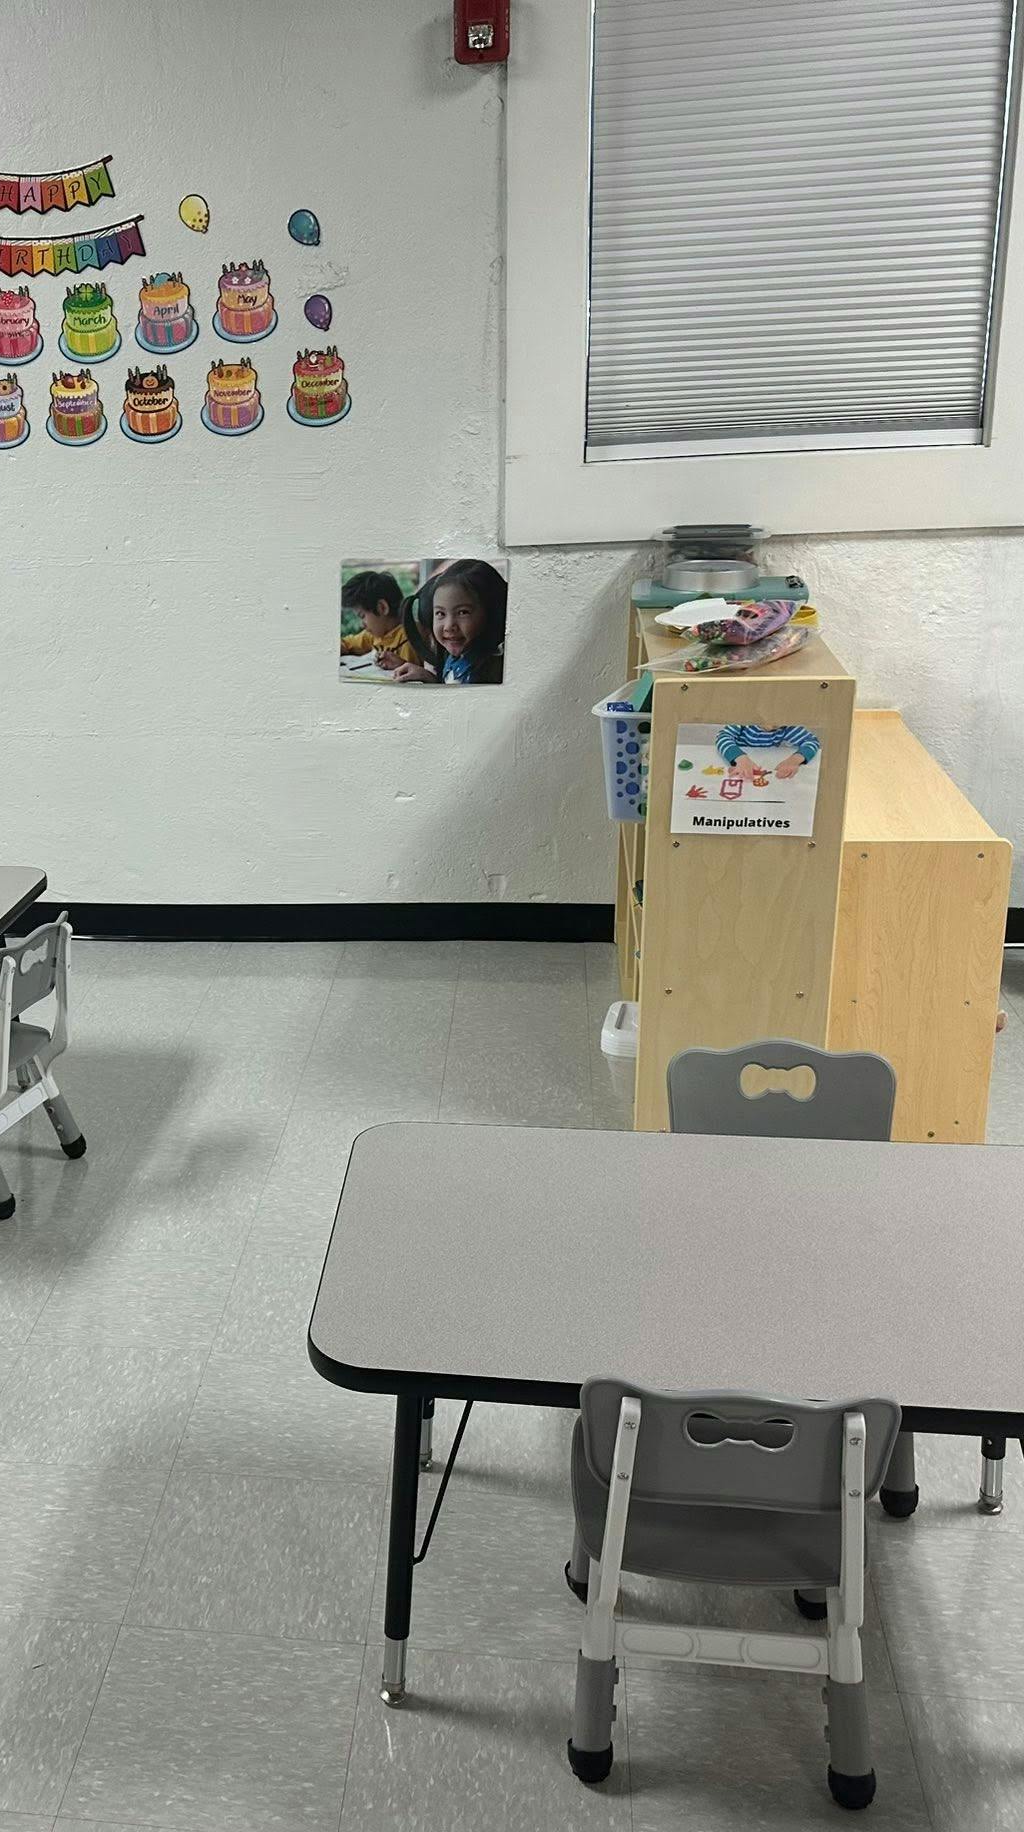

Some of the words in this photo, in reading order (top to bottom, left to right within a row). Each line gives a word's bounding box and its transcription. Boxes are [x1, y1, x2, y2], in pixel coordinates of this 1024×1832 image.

[0, 172, 101, 199] HAPPY
[237, 294, 257, 306] May
[153, 304, 180, 318] April
[73, 313, 106, 325] March
[301, 378, 339, 389] December
[213, 388, 252, 397] November
[57, 399, 93, 409] September
[133, 397, 169, 407] October
[692, 816, 791, 830] Manipulatives
